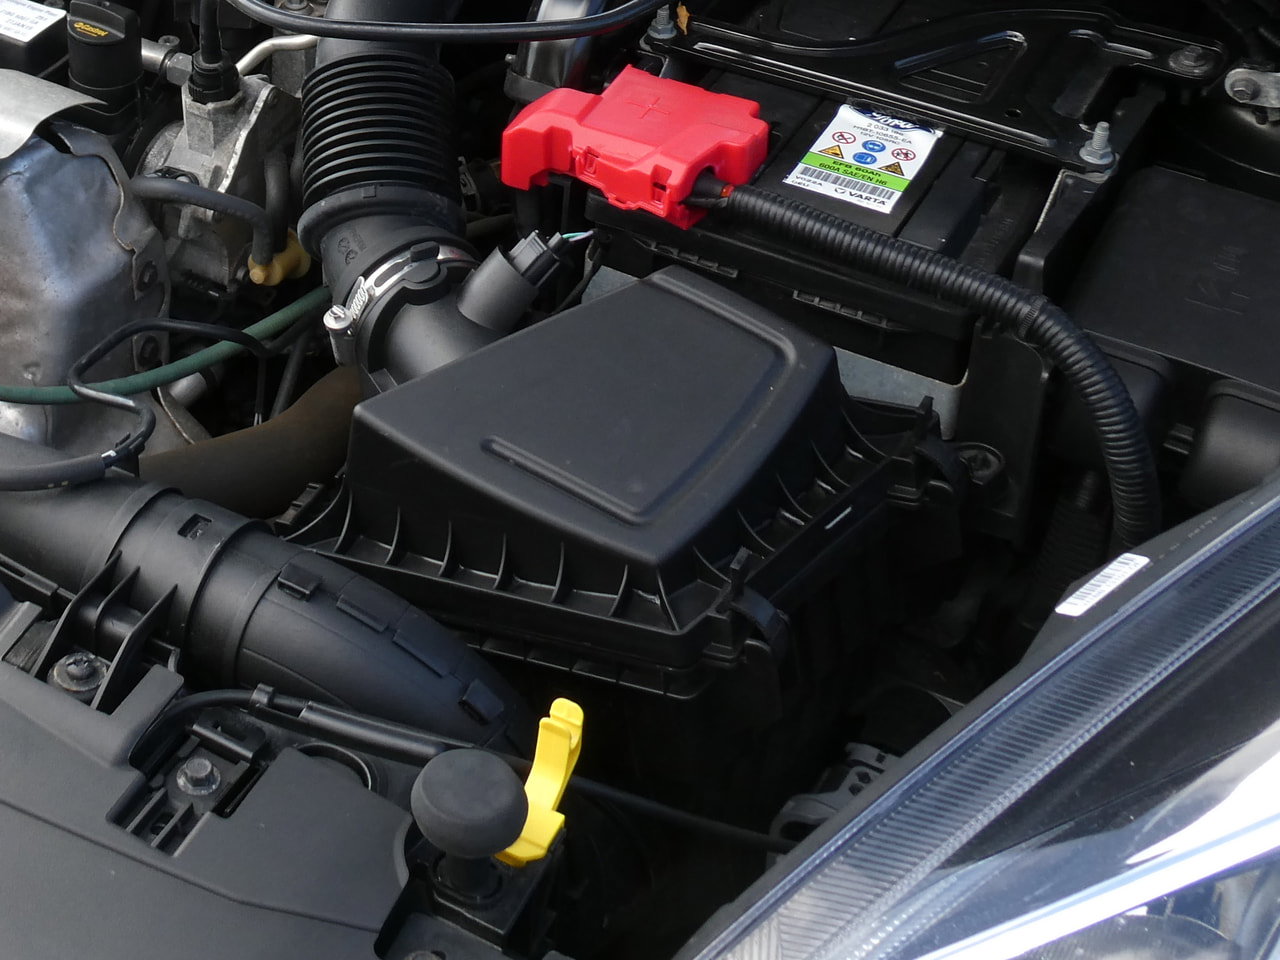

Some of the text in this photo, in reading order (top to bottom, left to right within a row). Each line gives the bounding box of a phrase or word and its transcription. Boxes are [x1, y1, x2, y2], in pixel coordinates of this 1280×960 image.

[832, 160, 852, 168] EFB
[818, 162, 840, 172] 600A
[841, 168, 873, 181] SAE/EN
[848, 191, 886, 205] VARTA
